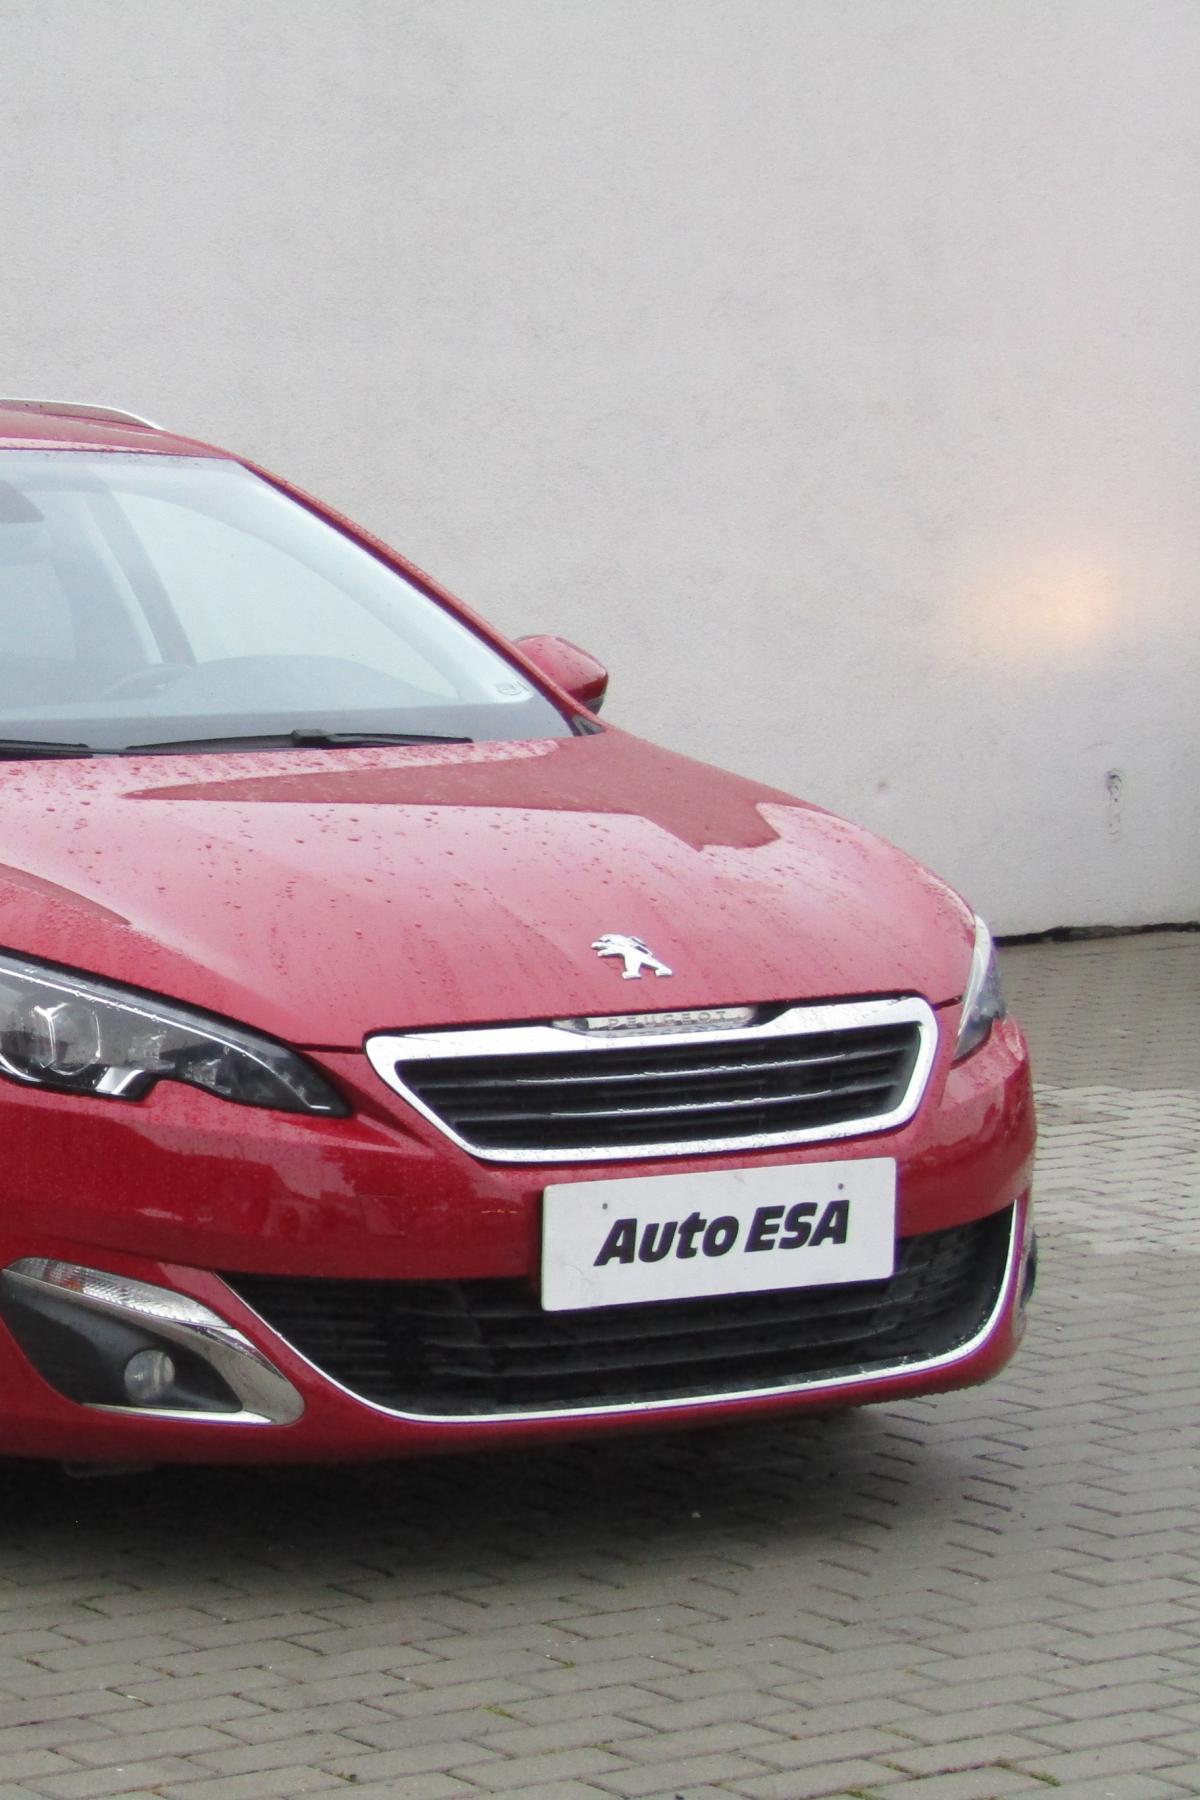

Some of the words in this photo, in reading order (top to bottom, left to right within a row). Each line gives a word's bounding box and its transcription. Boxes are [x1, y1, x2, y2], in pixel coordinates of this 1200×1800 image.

[608, 1010, 727, 1029] PEUGEOT
[594, 1212, 740, 1267] Auto
[744, 1200, 850, 1253] ESA
